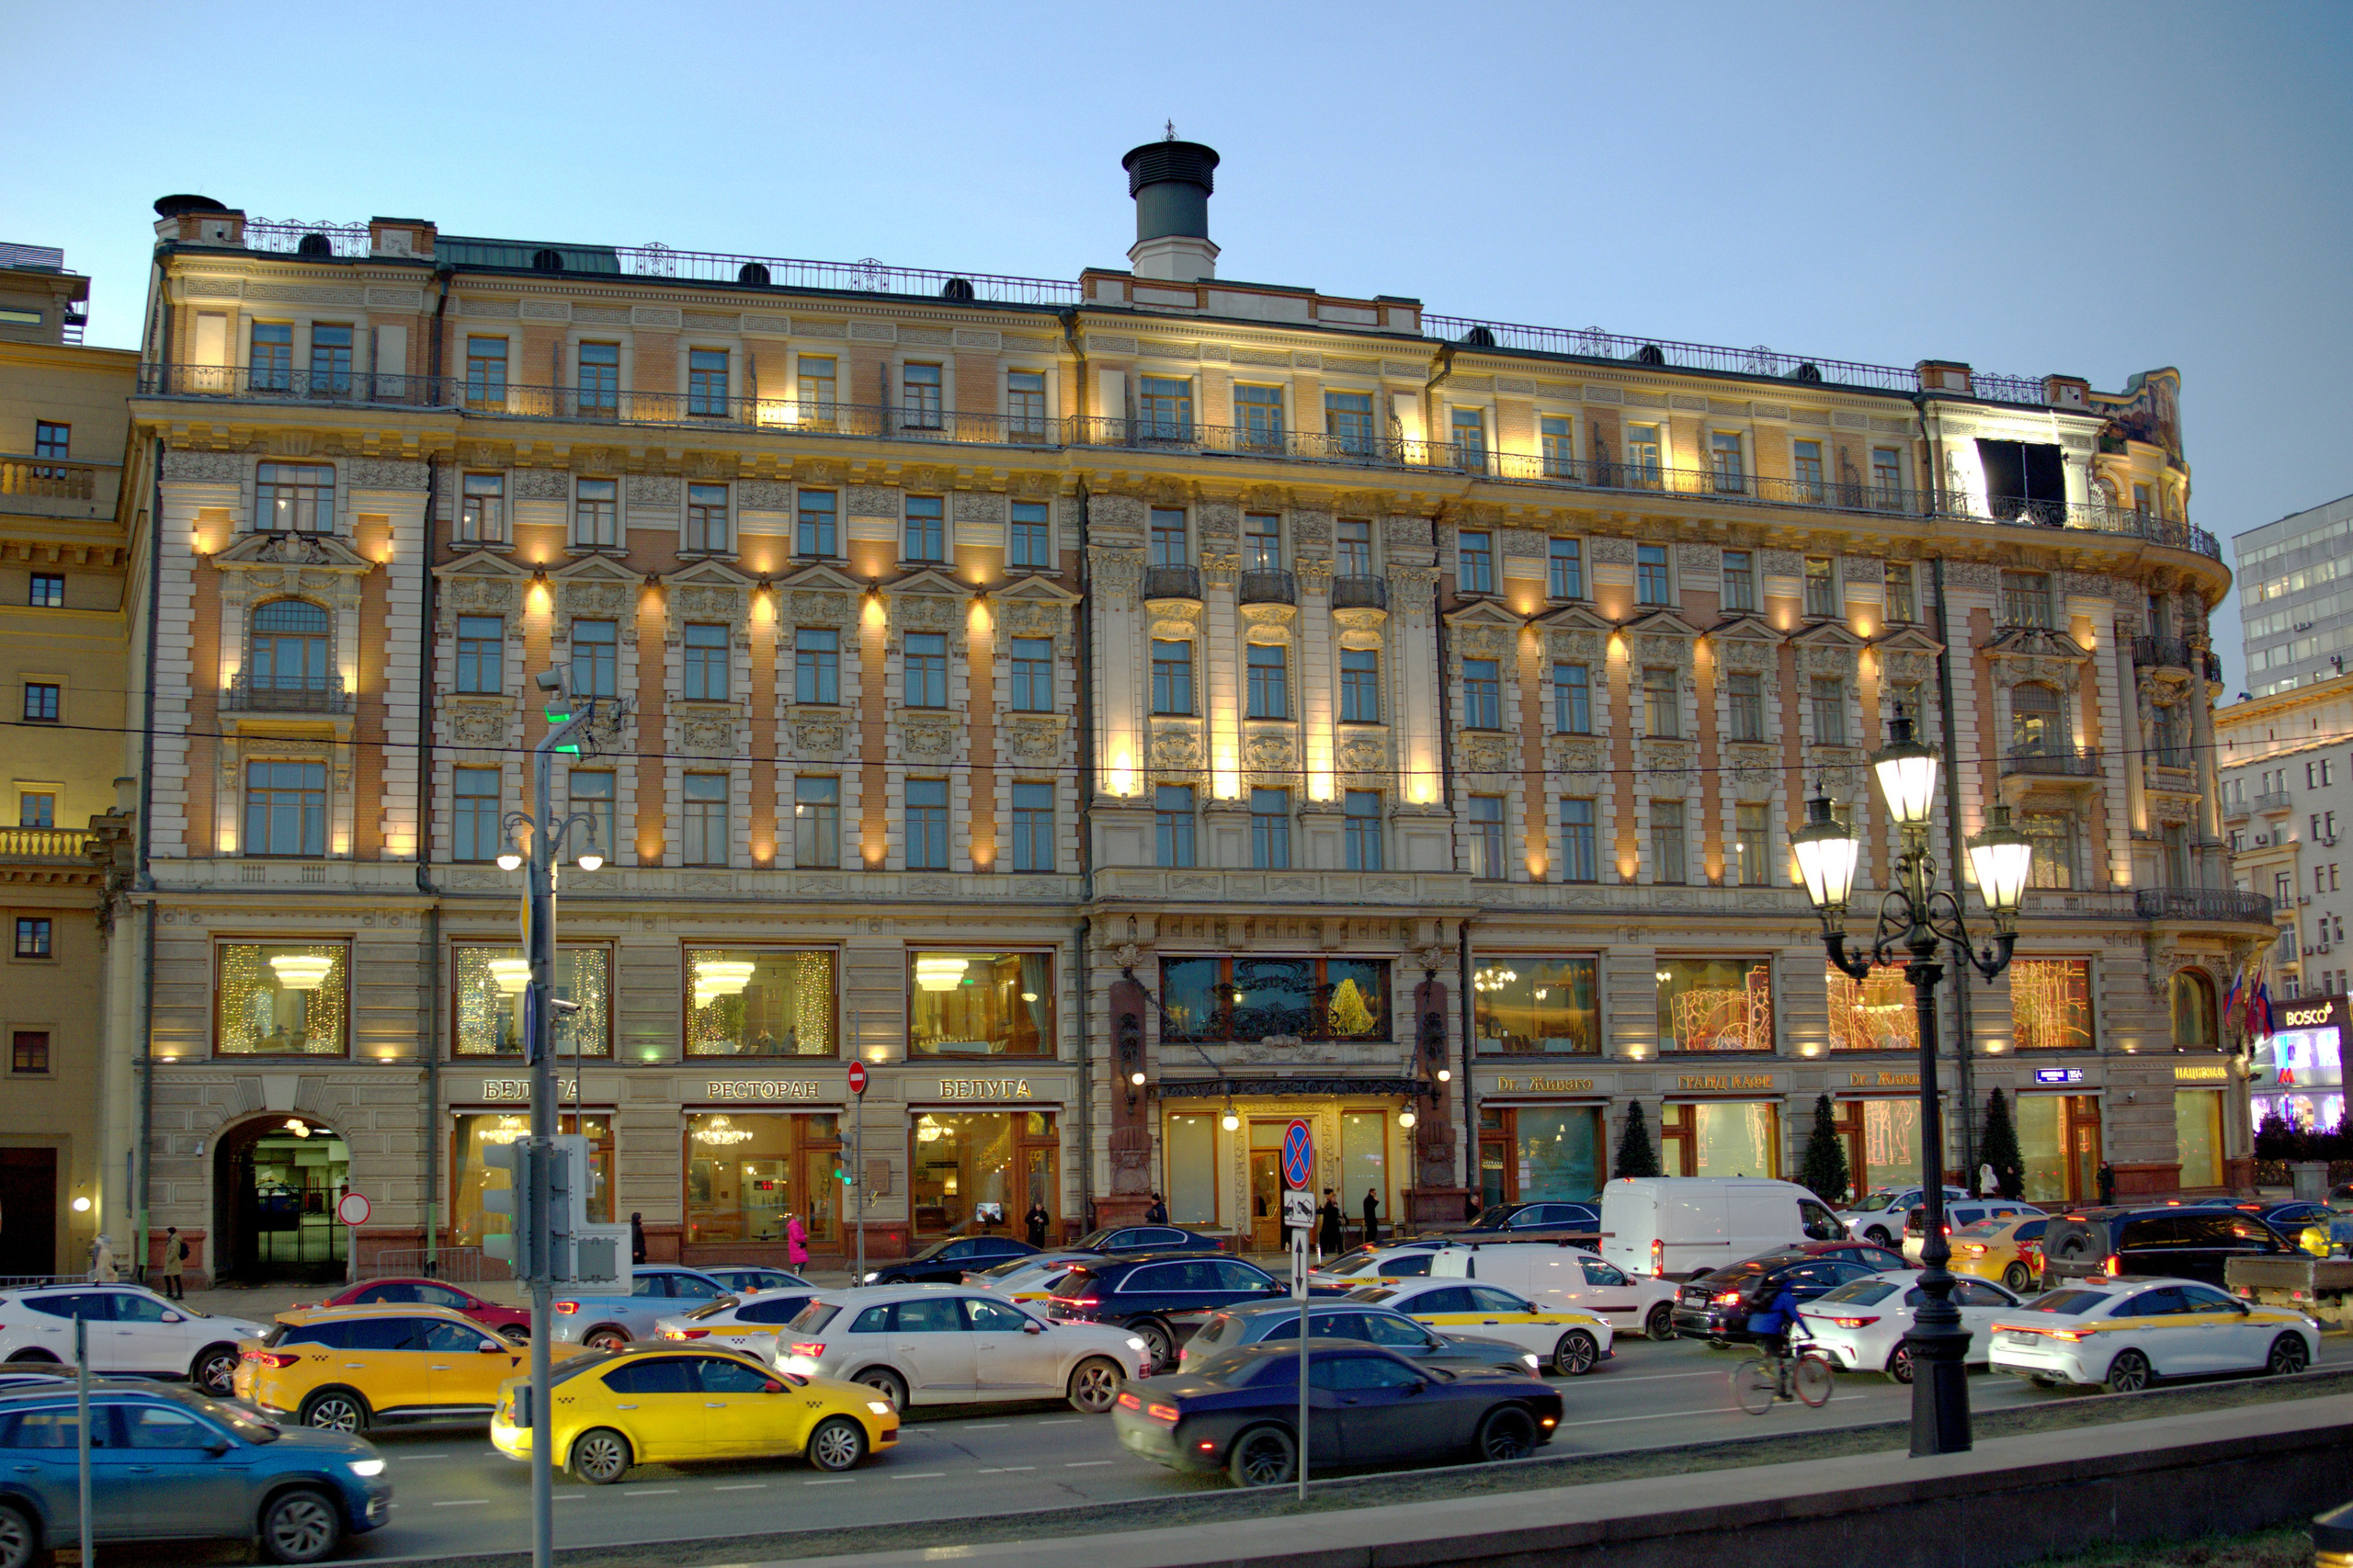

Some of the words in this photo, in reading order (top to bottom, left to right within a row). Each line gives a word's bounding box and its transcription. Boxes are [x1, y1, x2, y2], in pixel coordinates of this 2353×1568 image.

[2286, 1009, 2327, 1026] BOSCO
[1497, 1076, 1521, 1091] Dr.
[1529, 1076, 1594, 1091] Живаго
[1677, 1074, 1729, 1091] ГРАНД
[1731, 1074, 1774, 1089] КАФЕ
[1849, 1072, 1871, 1085] Dr.
[1876, 1071, 1920, 1085] Жива
[483, 1079, 583, 1099] БЕЛА
[707, 1081, 820, 1098] РЕСТОРАН
[939, 1078, 1033, 1098] БЕЛУГА
